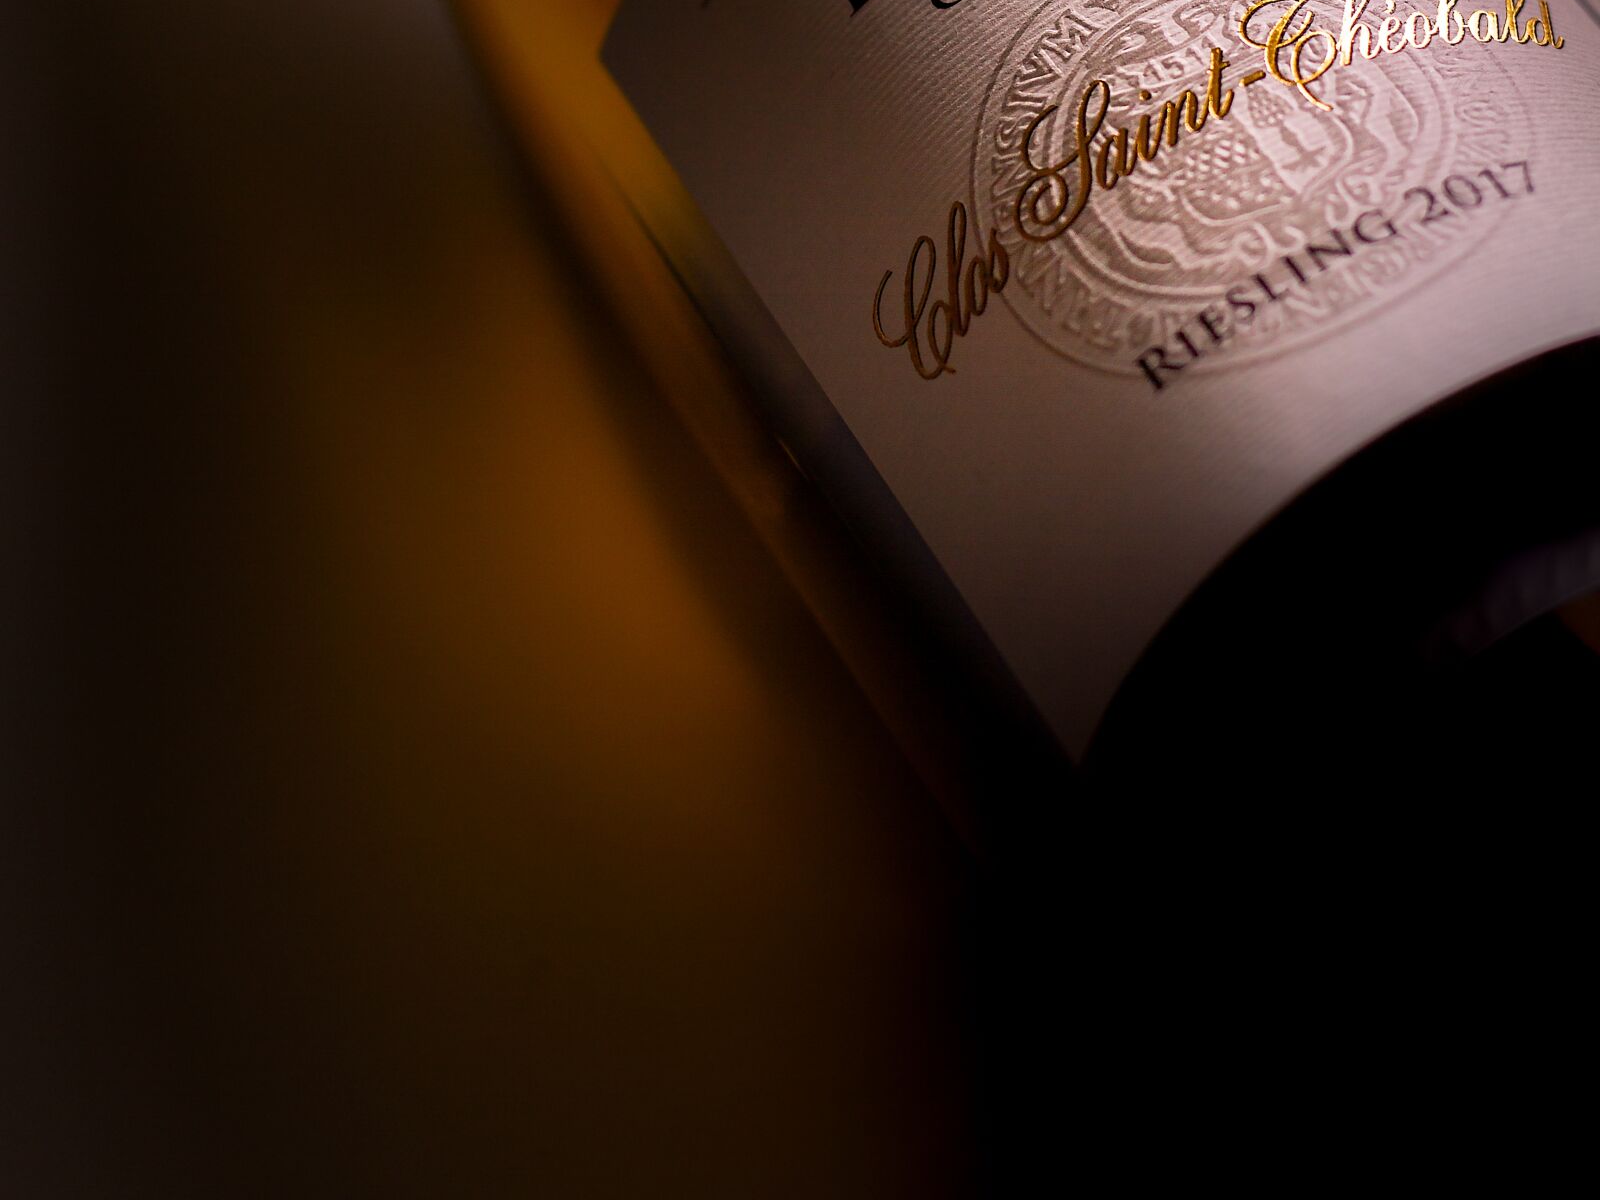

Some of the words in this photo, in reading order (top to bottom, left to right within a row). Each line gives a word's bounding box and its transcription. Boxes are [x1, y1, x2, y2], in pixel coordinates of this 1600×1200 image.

[872, 200, 1010, 380] Clos
[1134, 207, 1400, 392] RIESLING
[1403, 160, 1537, 226] 2017
